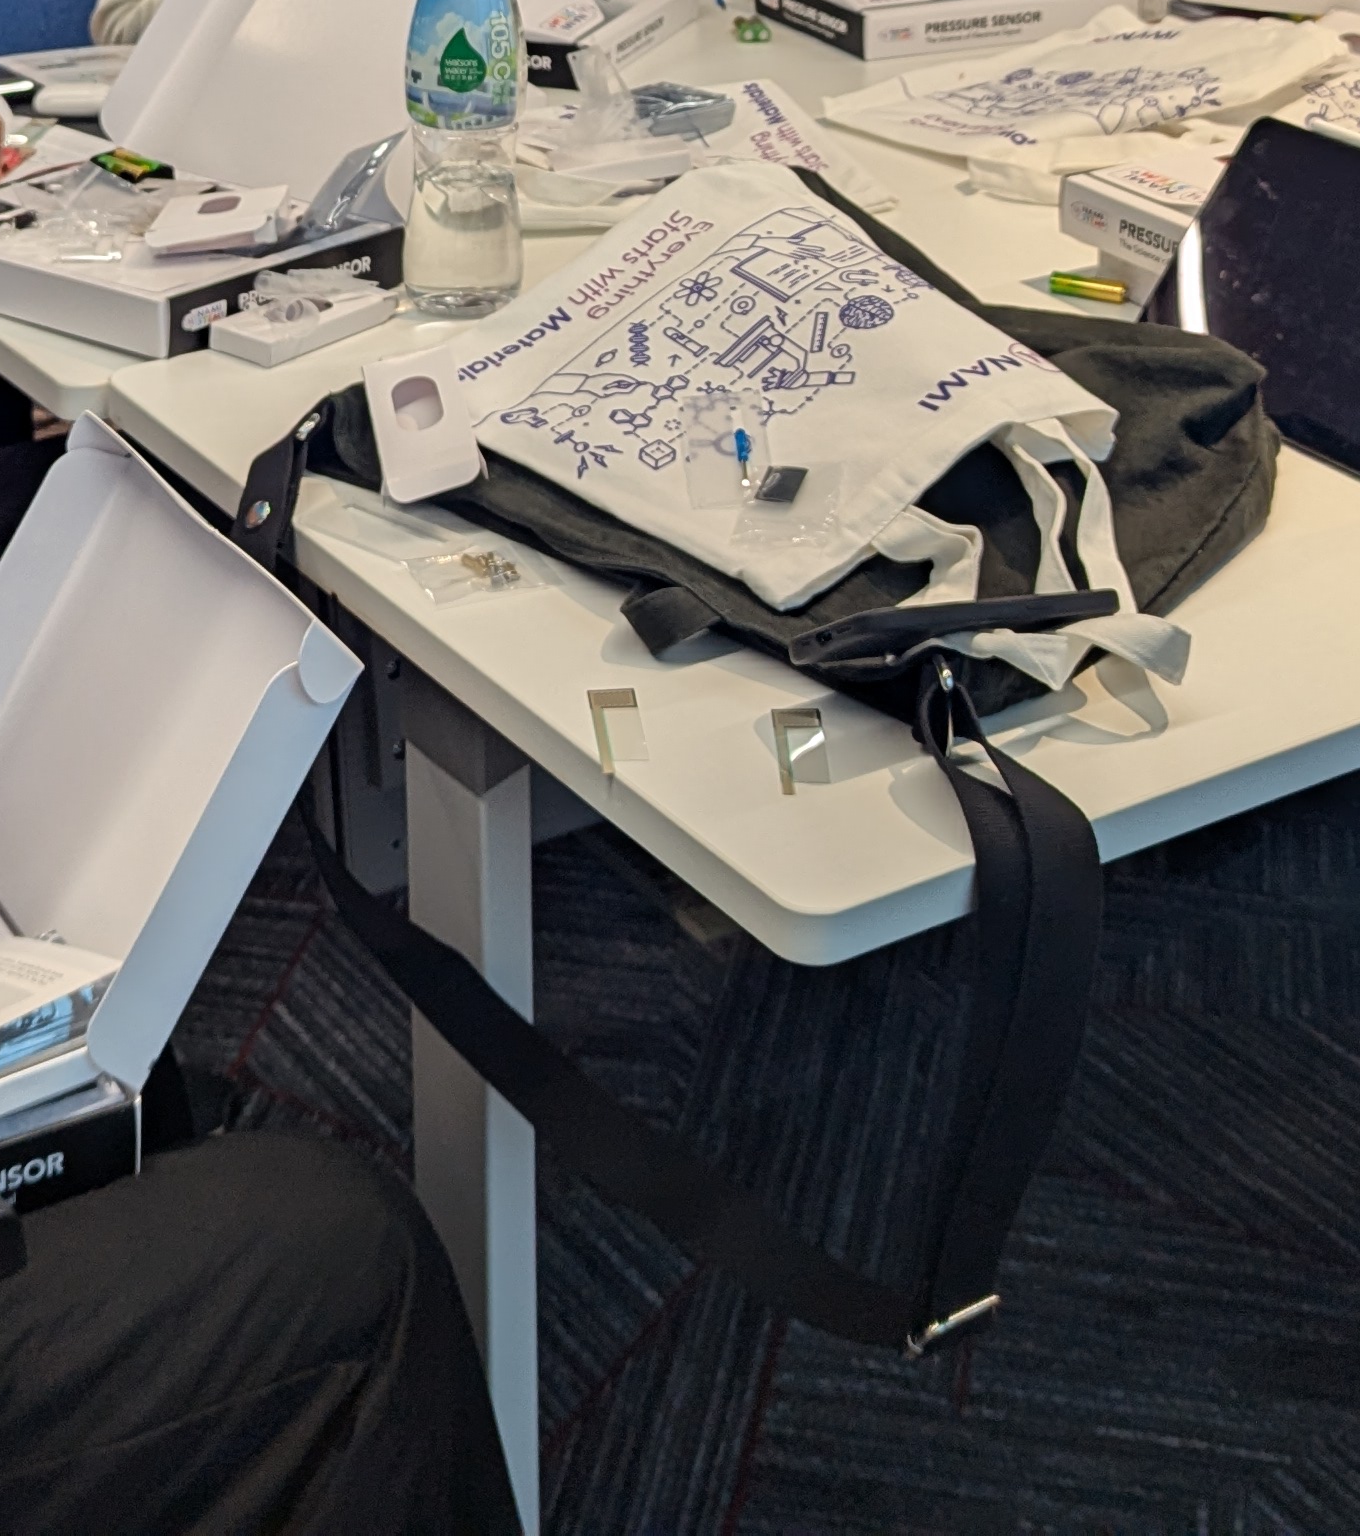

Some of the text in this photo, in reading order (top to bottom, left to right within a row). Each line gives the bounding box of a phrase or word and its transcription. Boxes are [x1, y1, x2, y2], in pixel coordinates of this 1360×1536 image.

[924, 14, 990, 34] PRESSURE
[991, 11, 1042, 27] SENSOR
[742, 82, 787, 126] Materials
[750, 130, 789, 163] ything
[621, 209, 694, 265] Starts
[1118, 219, 1180, 255] PRESSUR
[567, 266, 626, 306] with
[586, 220, 715, 320] Everything
[917, 354, 1023, 412] NAMI
